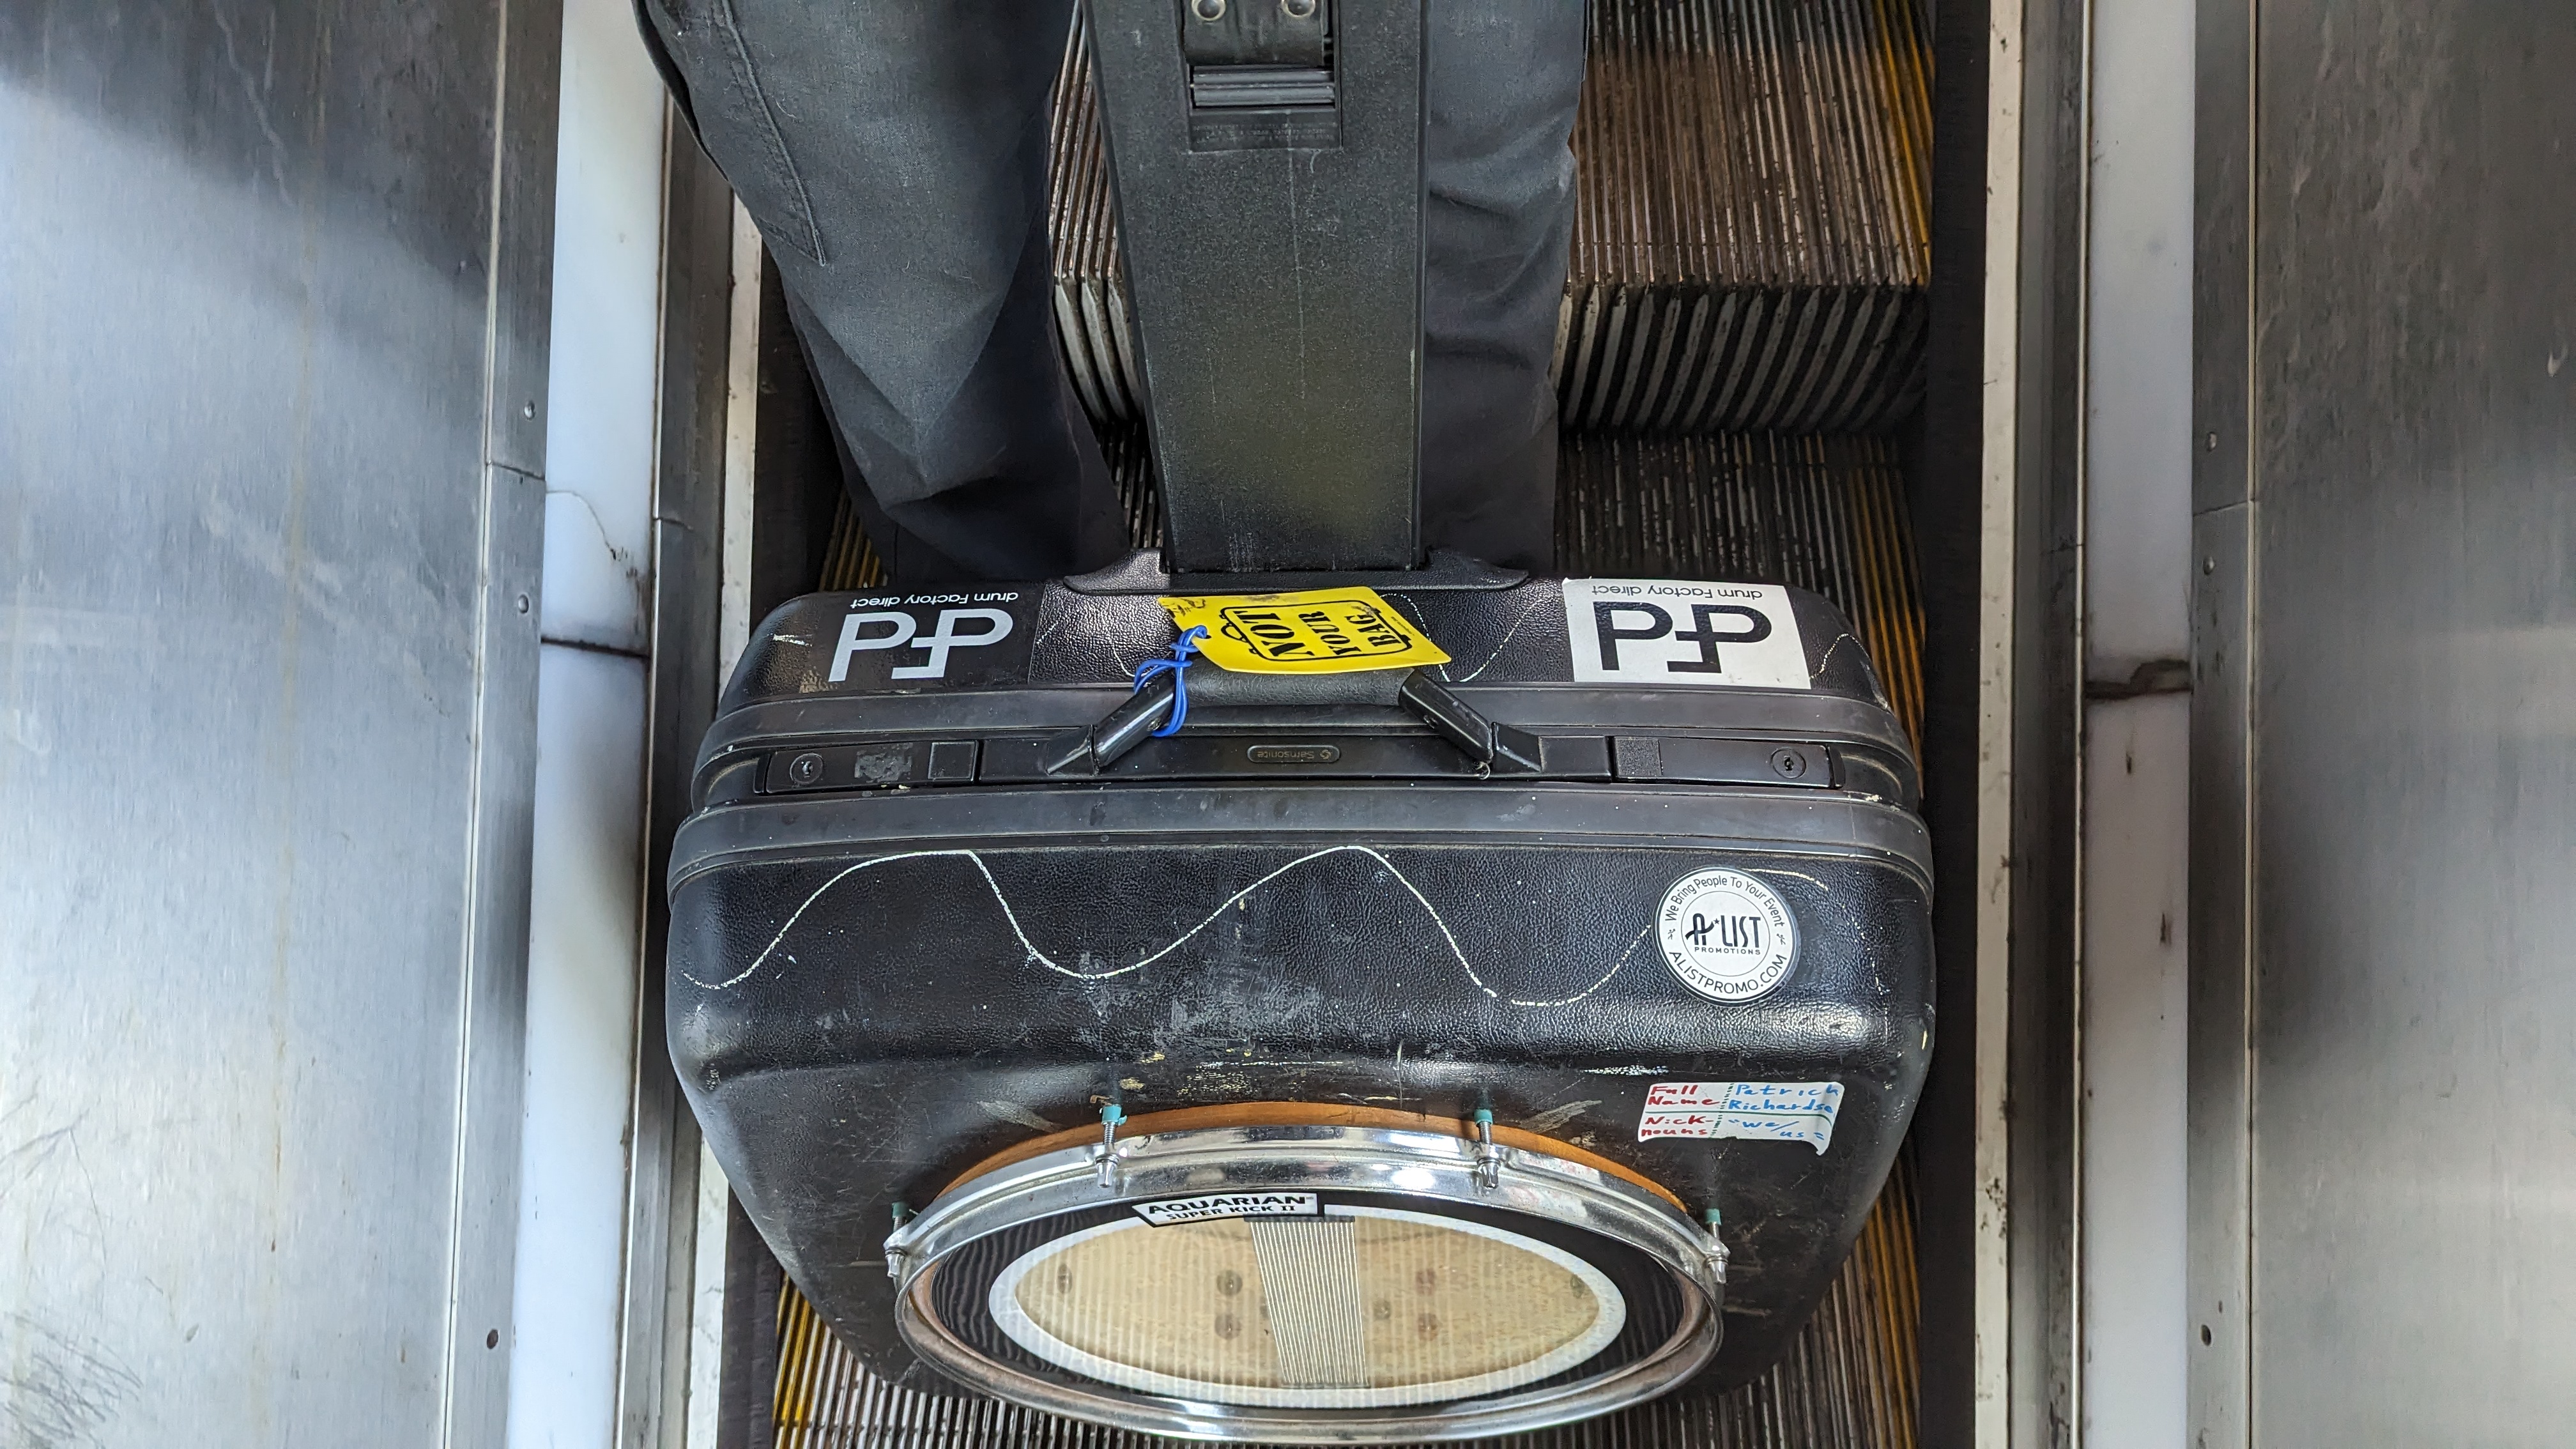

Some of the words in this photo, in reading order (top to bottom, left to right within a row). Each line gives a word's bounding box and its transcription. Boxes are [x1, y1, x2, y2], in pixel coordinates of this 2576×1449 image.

[974, 592, 1019, 602] drum
[1592, 585, 1642, 597] direct
[1648, 585, 1713, 599] Factory
[1718, 588, 1763, 600] drum
[850, 597, 900, 608] direct
[905, 594, 969, 605] Factory
[1233, 610, 1315, 657] NOT
[1298, 610, 1362, 656] YOUR
[1345, 613, 1402, 647] BAG
[1257, 750, 1314, 759] Samsonite
[1693, 875, 1728, 889] People
[1730, 877, 1742, 889] To
[1671, 884, 1698, 905] Bring
[1745, 881, 1767, 900] Your
[1665, 905, 1679, 921] We
[1763, 897, 1786, 927] Event
[1694, 947, 1761, 955] PROMOTIONS
[1669, 951, 1788, 994] ALISTPROMO.COM
[1735, 1084, 1839, 1096] Patrick
[1648, 1096, 1720, 1105] Name
[1149, 1196, 1306, 1214] AQUARIAN
[1166, 1208, 1224, 1220] SUPER
[1230, 1204, 1273, 1213] KICK
